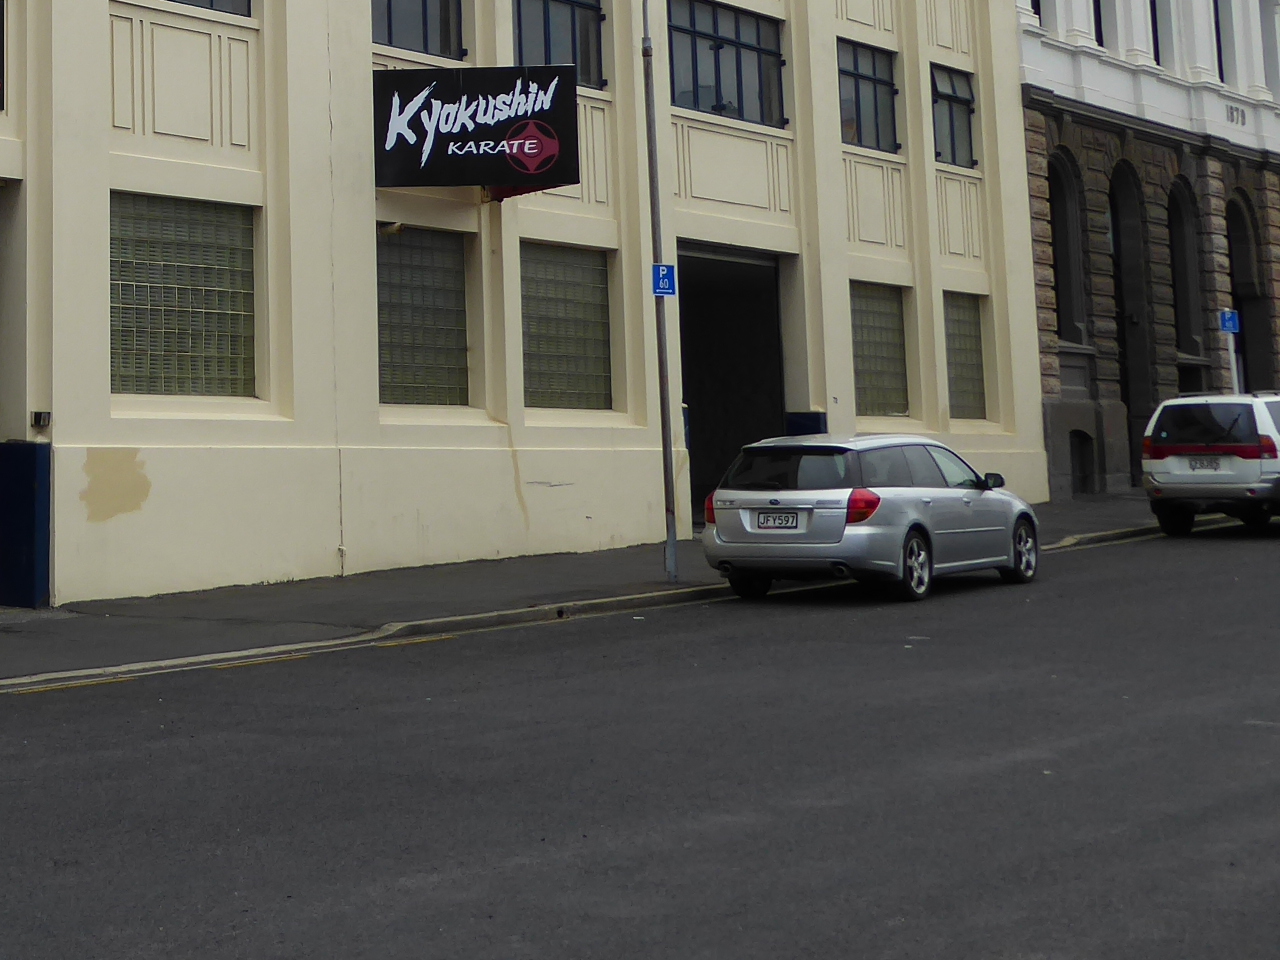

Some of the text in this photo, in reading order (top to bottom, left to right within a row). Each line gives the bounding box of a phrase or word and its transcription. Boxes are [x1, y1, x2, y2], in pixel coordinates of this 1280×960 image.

[447, 139, 538, 155] KARATE
[659, 266, 668, 278] P
[659, 278, 669, 289] 60
[760, 515, 796, 526] JFY597
